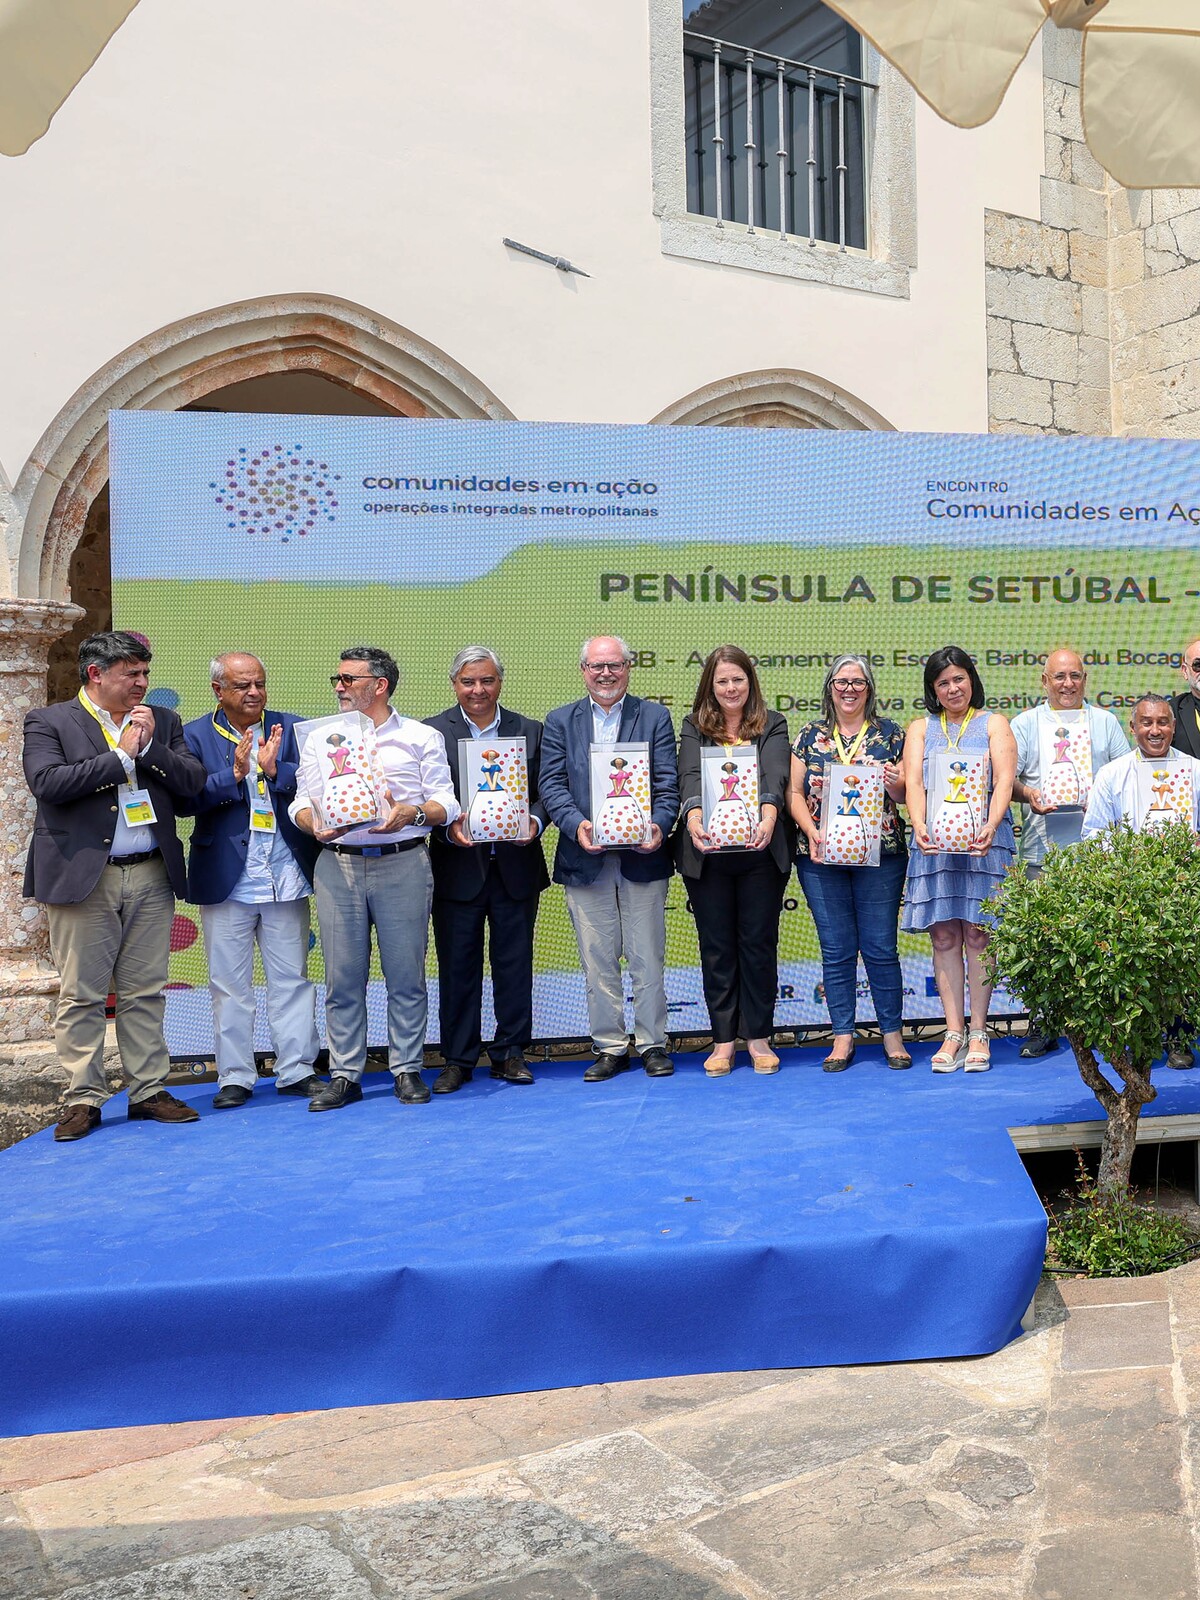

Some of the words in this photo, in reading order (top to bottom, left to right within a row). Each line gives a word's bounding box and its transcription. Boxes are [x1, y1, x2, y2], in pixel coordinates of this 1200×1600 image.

[926, 480, 1009, 493] ENCONTRO
[363, 501, 449, 515] operações
[452, 501, 537, 516] integradas
[541, 504, 659, 518] metropolitanas
[926, 498, 1111, 522] Comunidades
[1118, 505, 1159, 522] em
[600, 564, 877, 603] PENÍNSULA
[891, 575, 952, 603] DE
[967, 567, 1172, 604] SETÚBAL
[892, 649, 978, 667] Escs
[985, 648, 1049, 667] Barbo
[1083, 648, 1110, 666] du
[1116, 648, 1184, 669] Bocag
